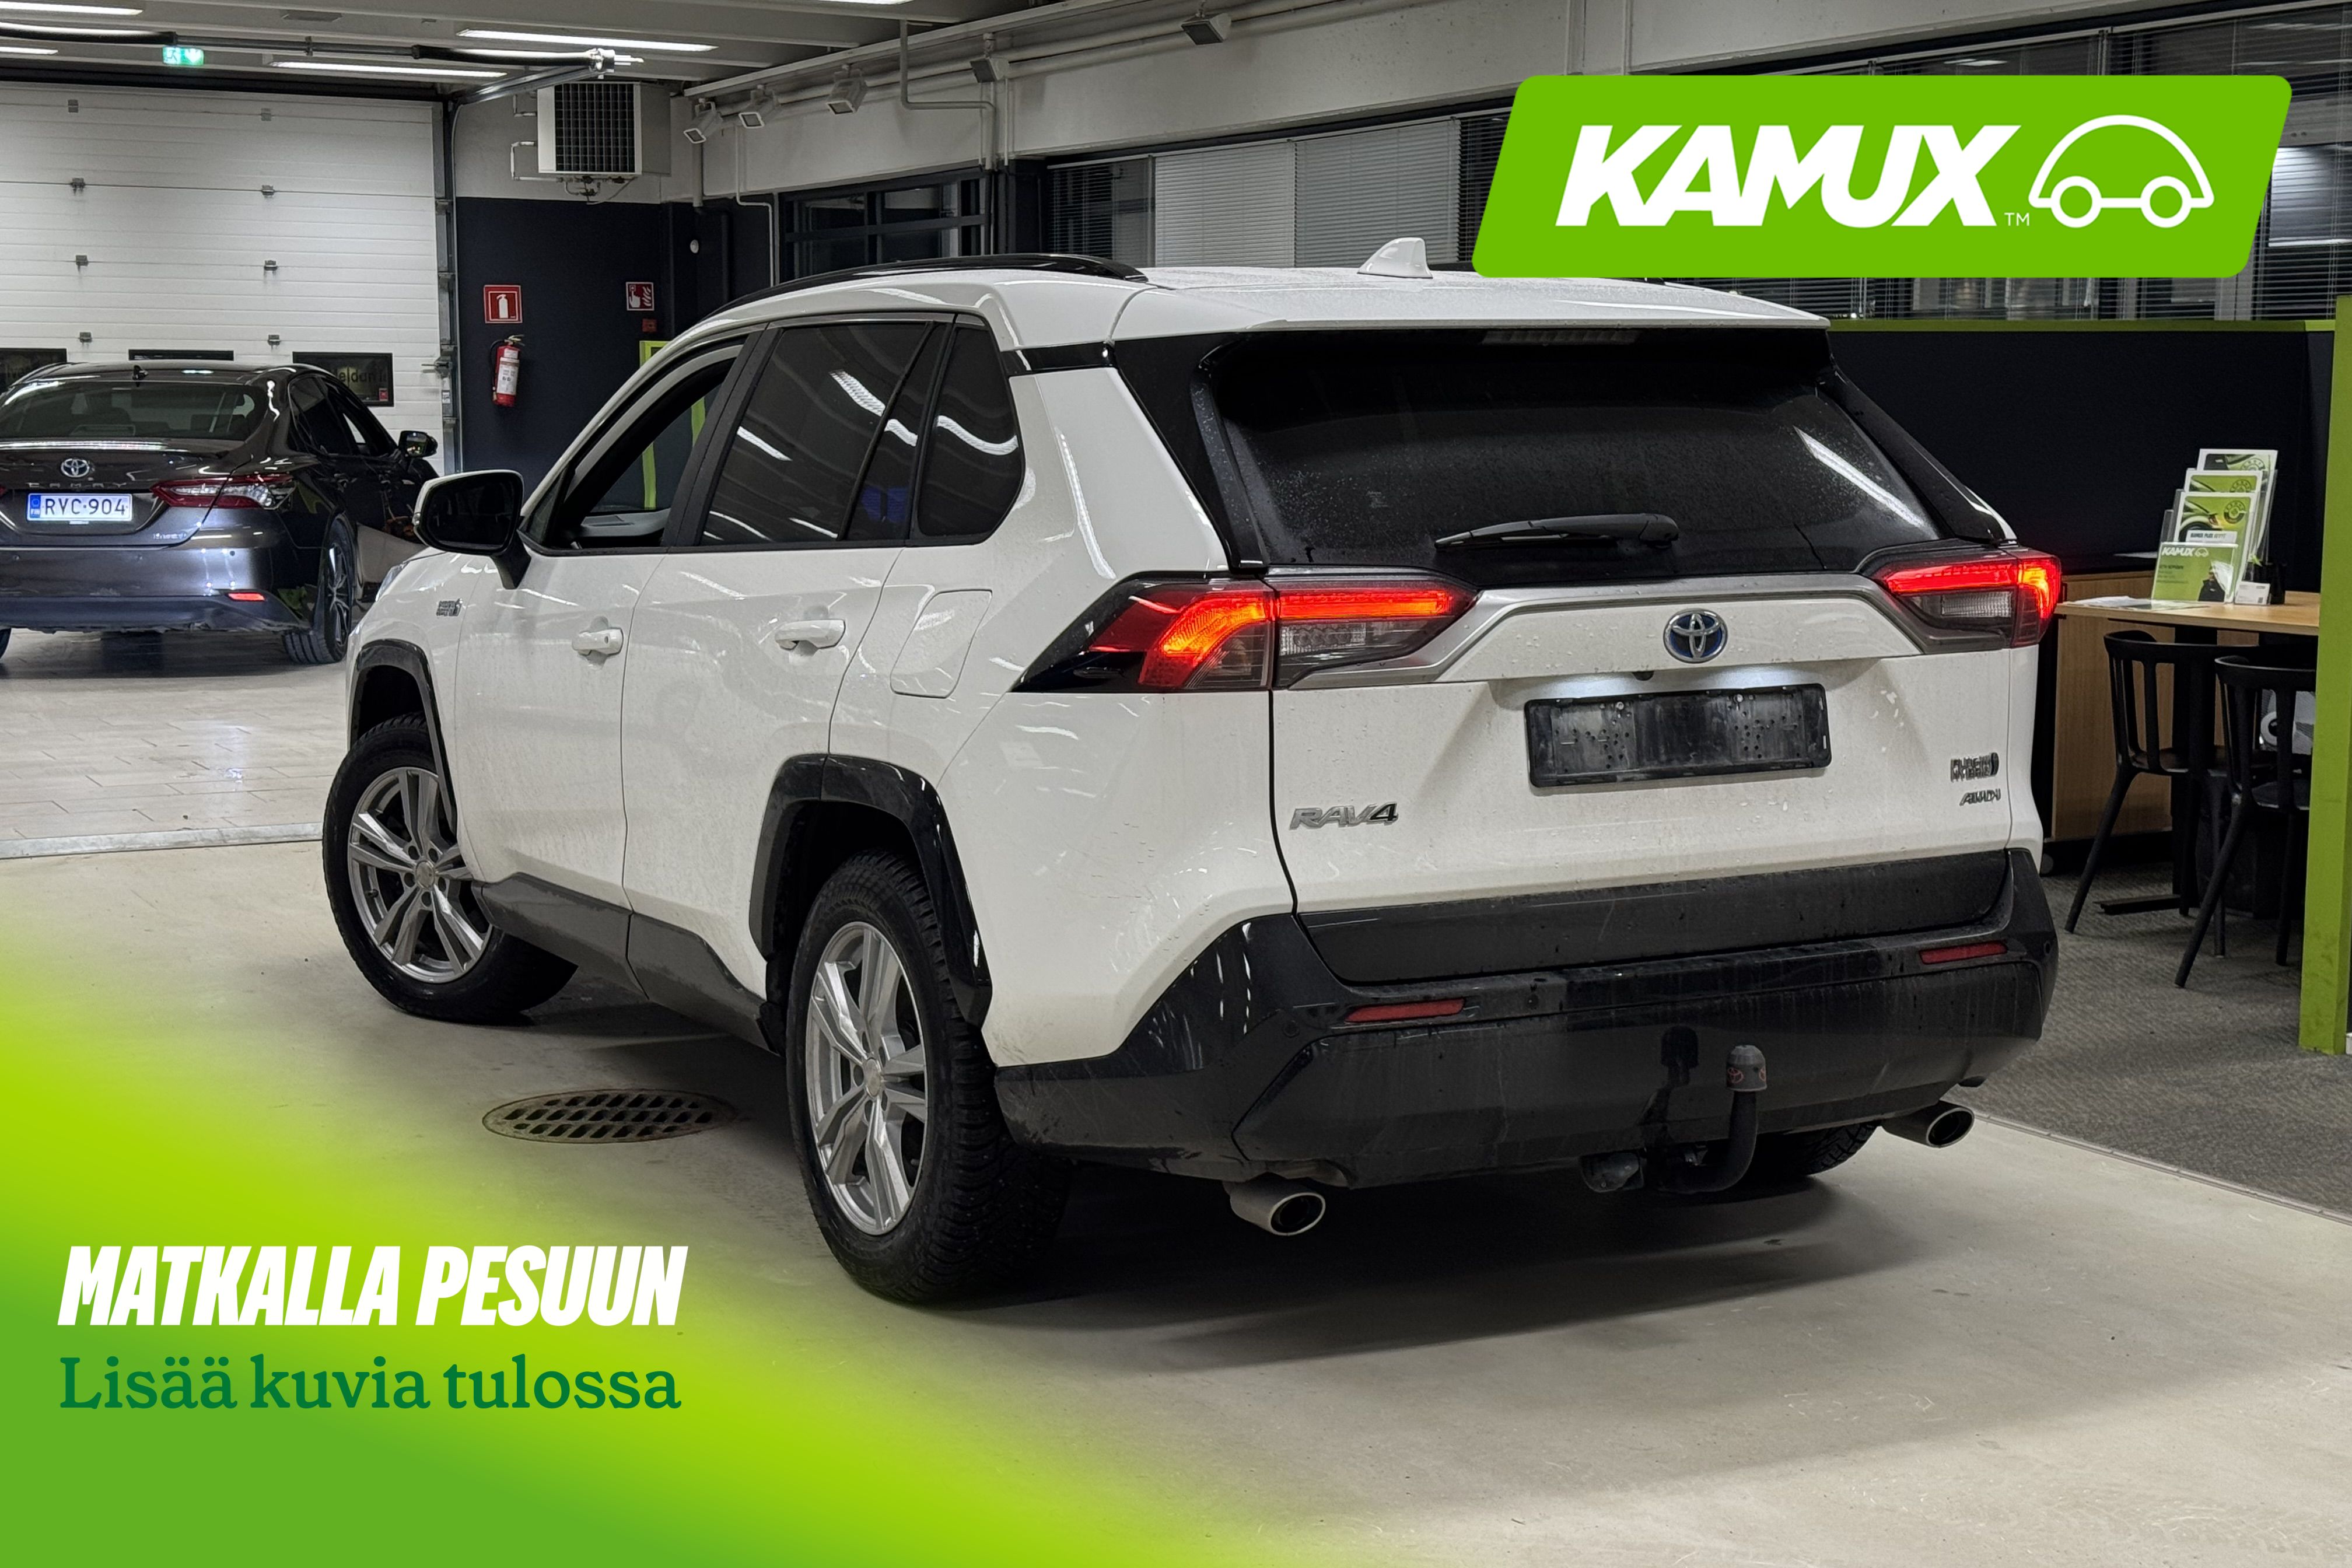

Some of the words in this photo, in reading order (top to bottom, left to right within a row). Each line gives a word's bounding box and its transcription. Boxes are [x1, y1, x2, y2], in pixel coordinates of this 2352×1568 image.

[45, 498, 125, 515] RYC-904
[2162, 547, 2195, 556] KAMUX
[1289, 802, 1399, 831] RAV4
